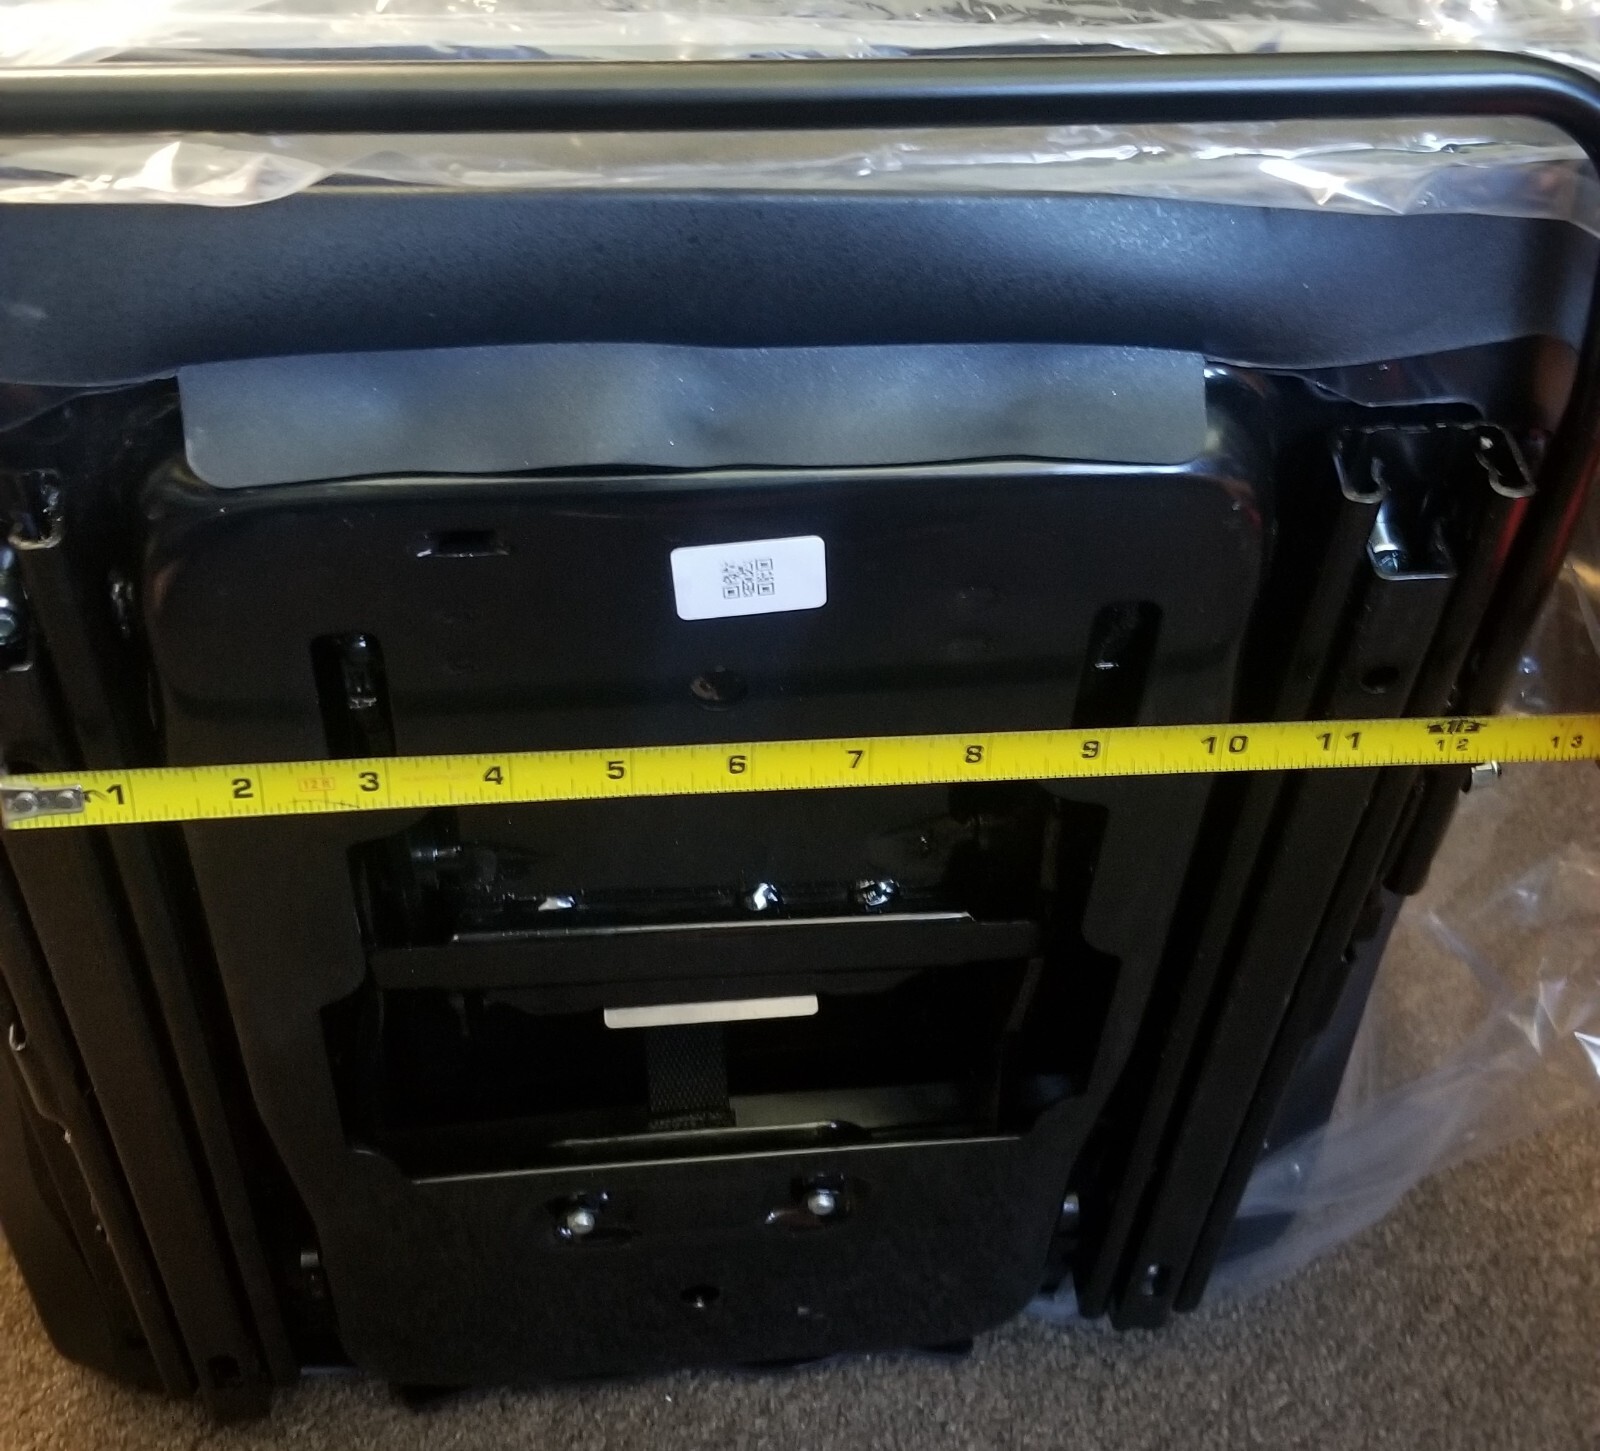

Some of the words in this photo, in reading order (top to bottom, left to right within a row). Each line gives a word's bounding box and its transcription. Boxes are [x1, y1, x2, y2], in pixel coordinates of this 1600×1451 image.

[105, 784, 126, 805] 1
[231, 777, 254, 799] 2
[358, 771, 381, 792] 3
[483, 765, 504, 785] 4
[607, 760, 626, 780] 5
[728, 755, 747, 775] 6
[847, 750, 864, 768] 7
[965, 744, 985, 764] 8
[1081, 740, 1100, 759] 9
[1200, 735, 1249, 754] 10
[1316, 732, 1362, 751] 11
[1436, 738, 1469, 752] 12
[1551, 734, 1584, 749] 13
